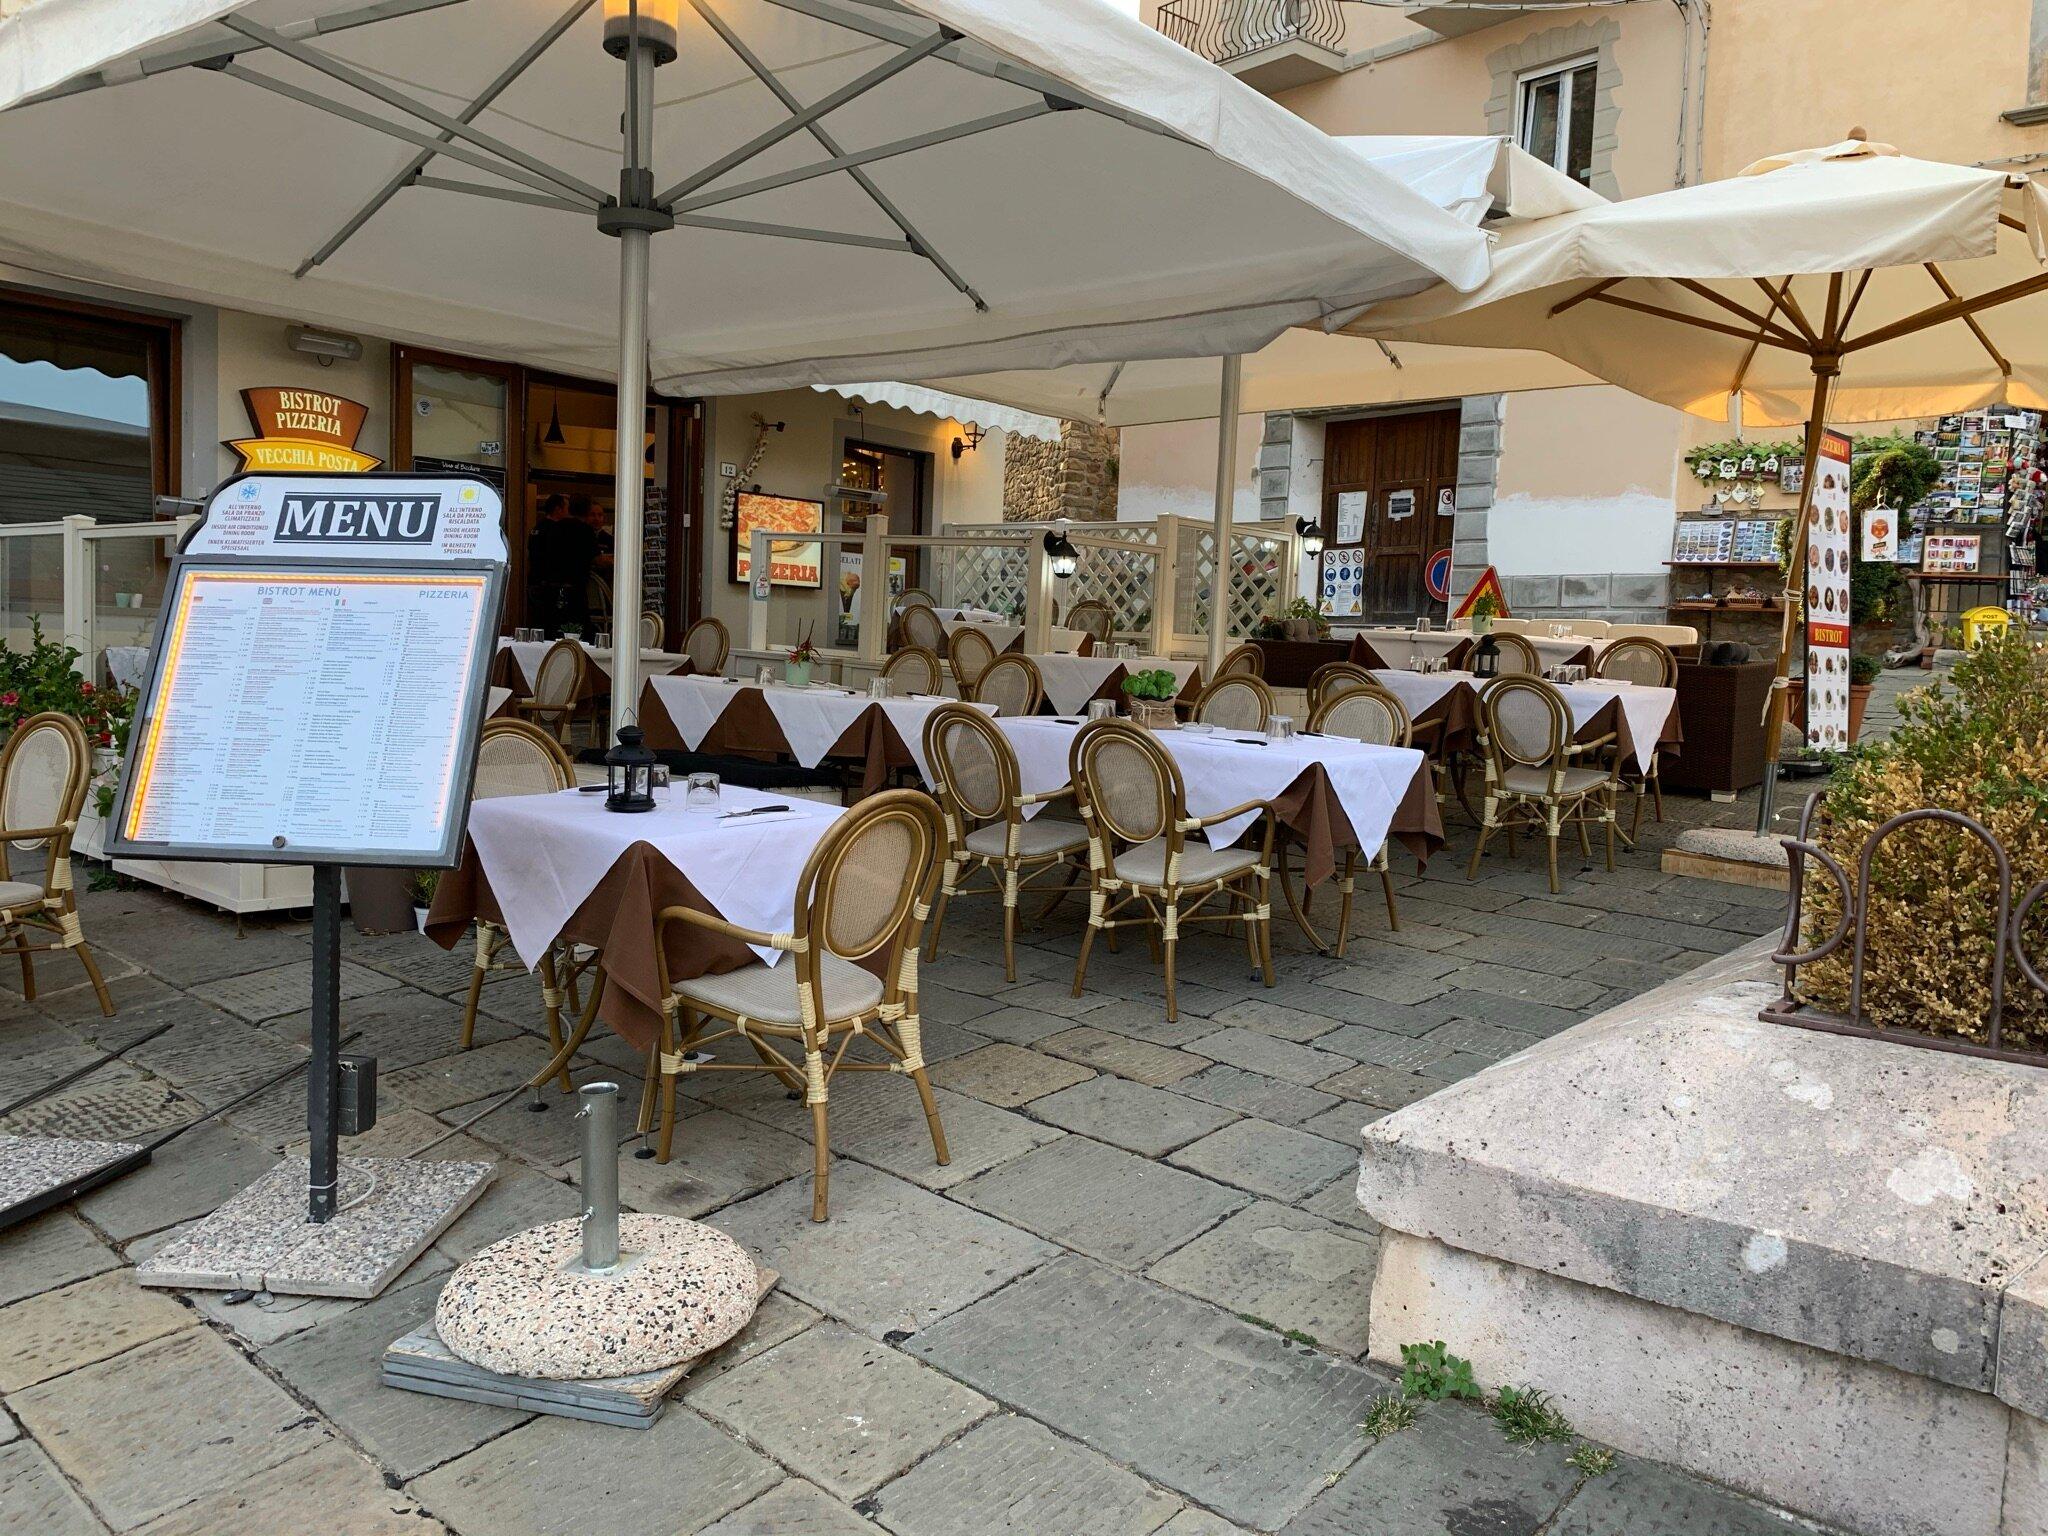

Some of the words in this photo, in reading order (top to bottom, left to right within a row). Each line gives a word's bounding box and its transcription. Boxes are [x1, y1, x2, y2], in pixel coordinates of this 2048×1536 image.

[279, 390, 342, 417] BISTROT
[276, 411, 343, 437] PIZZERIA
[256, 447, 315, 467] VECCHIA
[318, 452, 359, 472] POSTA
[725, 466, 733, 475] 12
[279, 500, 435, 538] MENU
[840, 556, 861, 565] ELATI
[738, 560, 818, 582] PZERIA
[257, 586, 306, 596] BISTROT
[418, 590, 469, 599] PIZZERIA
[1814, 627, 1843, 644] BISTROT
